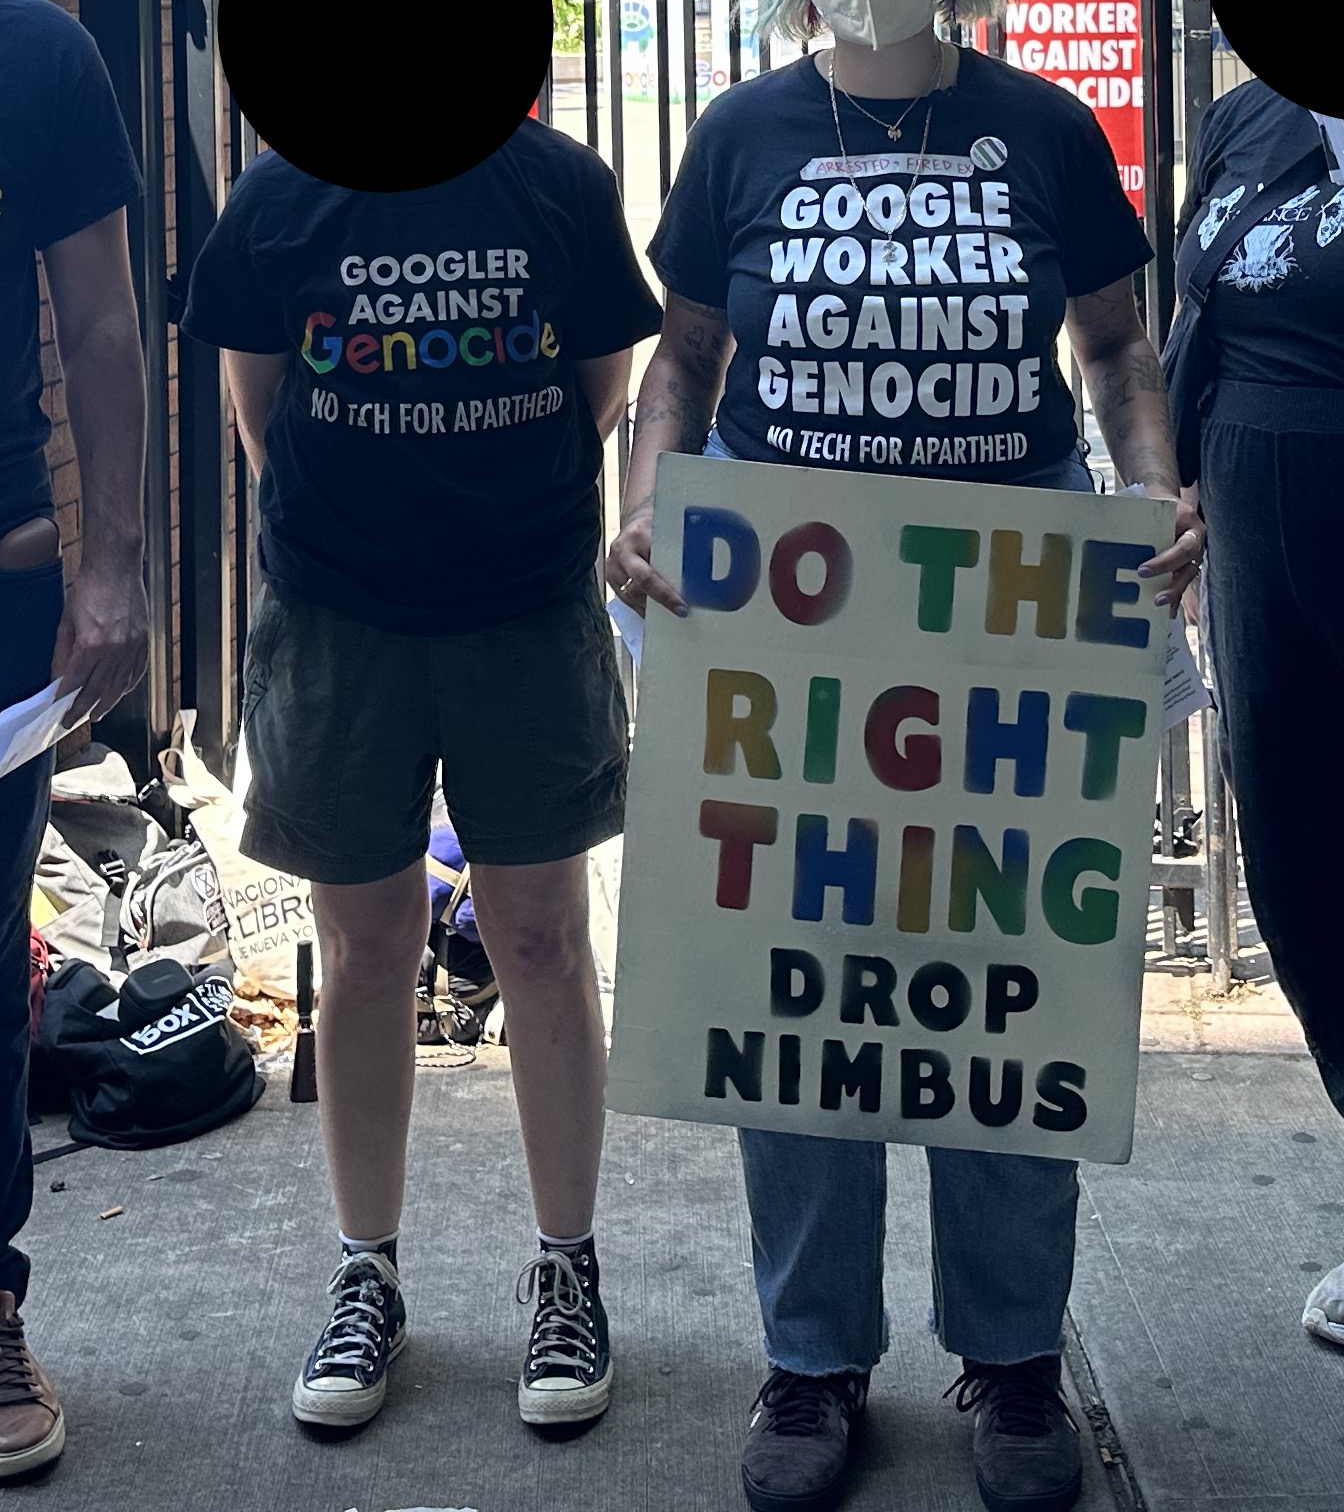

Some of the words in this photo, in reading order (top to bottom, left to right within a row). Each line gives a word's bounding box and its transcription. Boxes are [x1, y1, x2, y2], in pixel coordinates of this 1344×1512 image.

[1006, 3, 1137, 34] WORKER
[1006, 40, 1136, 72] AGAINST
[780, 181, 1011, 232] GOOGLE
[339, 249, 530, 287] GOOGLER
[769, 232, 1029, 285] WORKER
[347, 288, 523, 325] AGAINST
[767, 293, 1029, 351] AGAINST
[301, 310, 560, 374] Genocide
[311, 388, 339, 423] NO
[400, 402, 446, 434] FOR
[453, 386, 564, 433] APARTHEID
[758, 356, 1041, 418] GENOCIDE
[767, 425, 794, 453] NO
[800, 430, 852, 461] TECH
[859, 435, 903, 465] FOR
[910, 432, 1028, 465] APARTHEID
[682, 506, 854, 626] DO
[899, 525, 1156, 649] THE
[703, 668, 1147, 801] RIGHT
[698, 799, 1123, 945] THING
[770, 947, 1040, 1034] DROP
[704, 1027, 1088, 1133] NIMBUS
